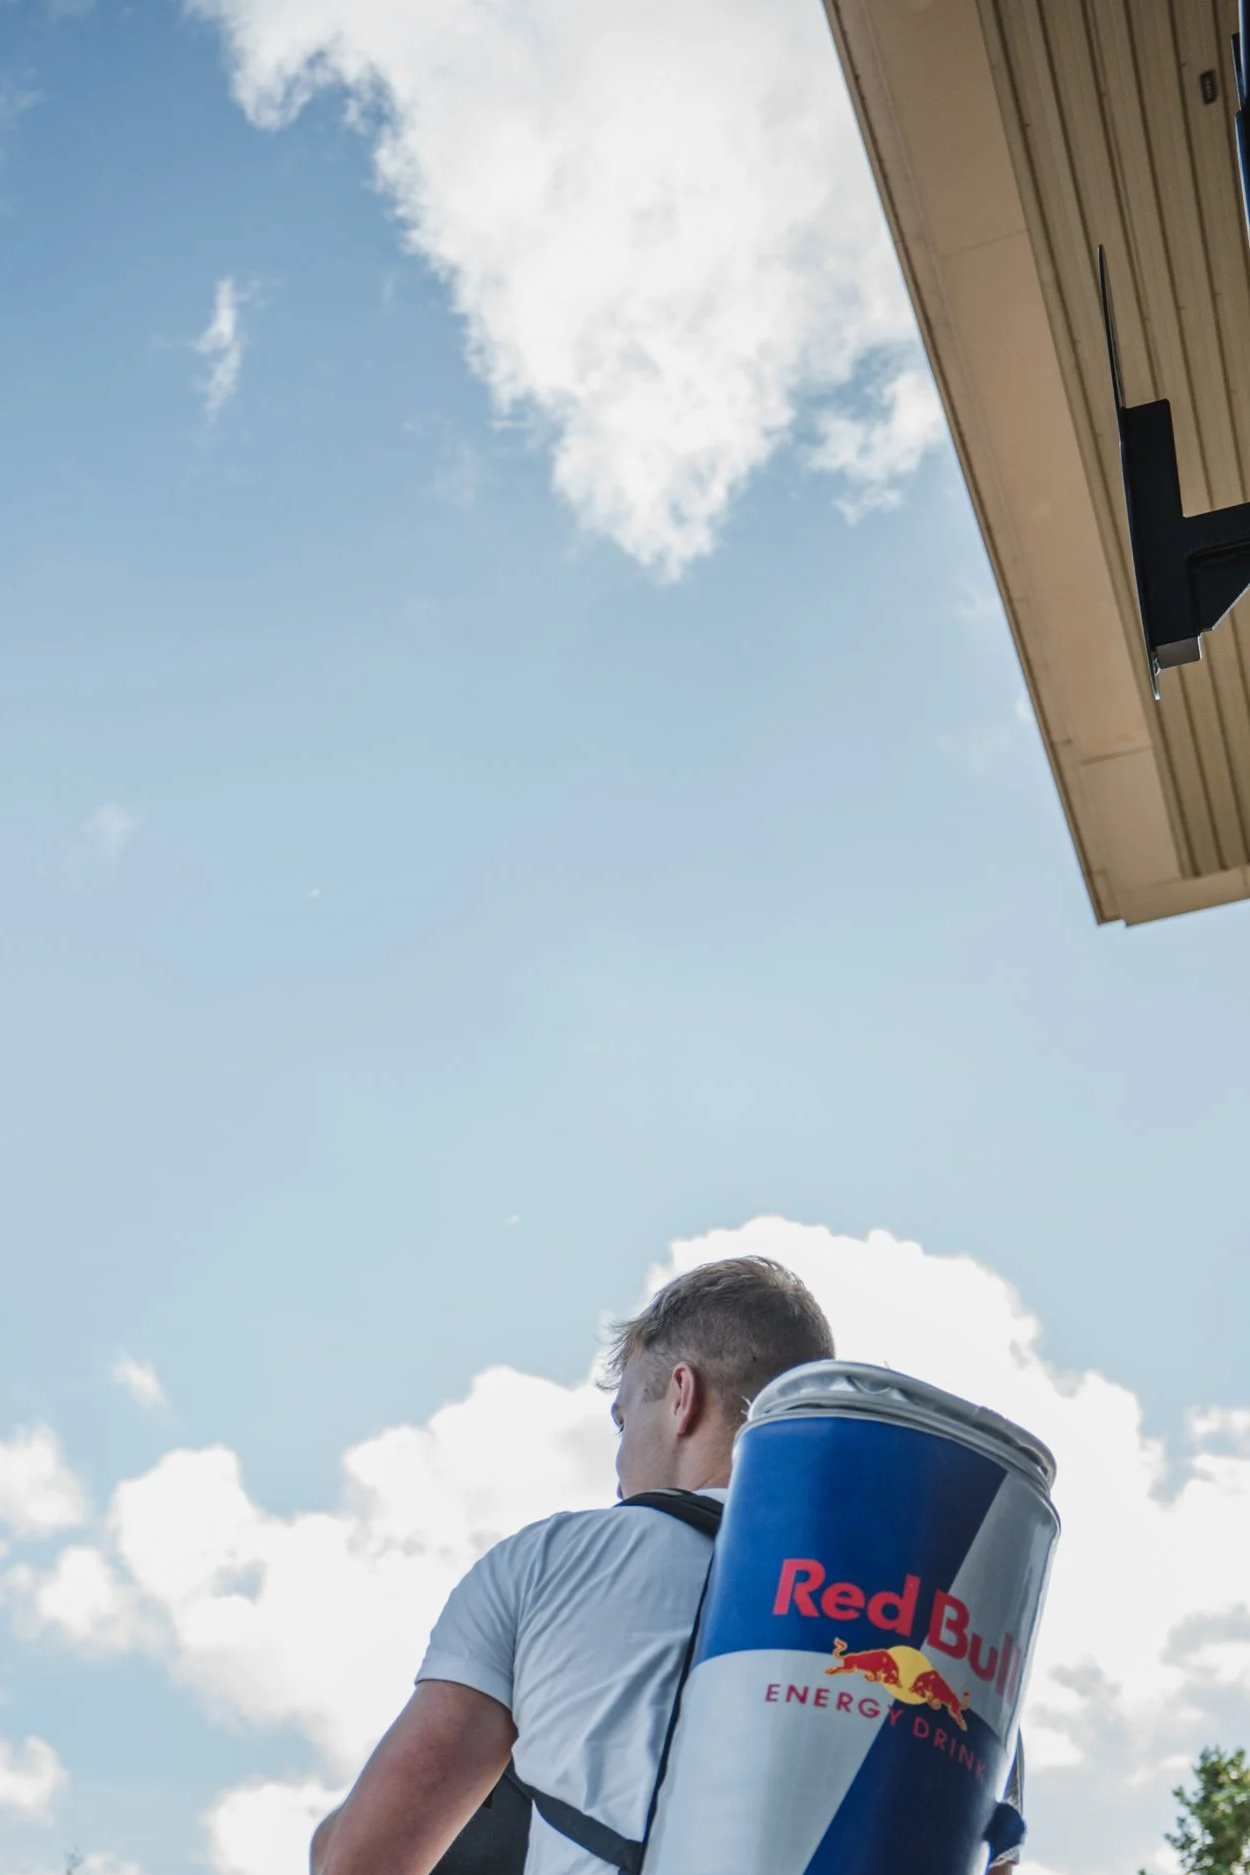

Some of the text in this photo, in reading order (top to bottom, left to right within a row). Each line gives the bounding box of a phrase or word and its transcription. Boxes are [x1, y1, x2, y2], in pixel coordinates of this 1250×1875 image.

[772, 1558, 1021, 1704] Red Bull
[764, 1683, 986, 1782] ENERGY DRINK
